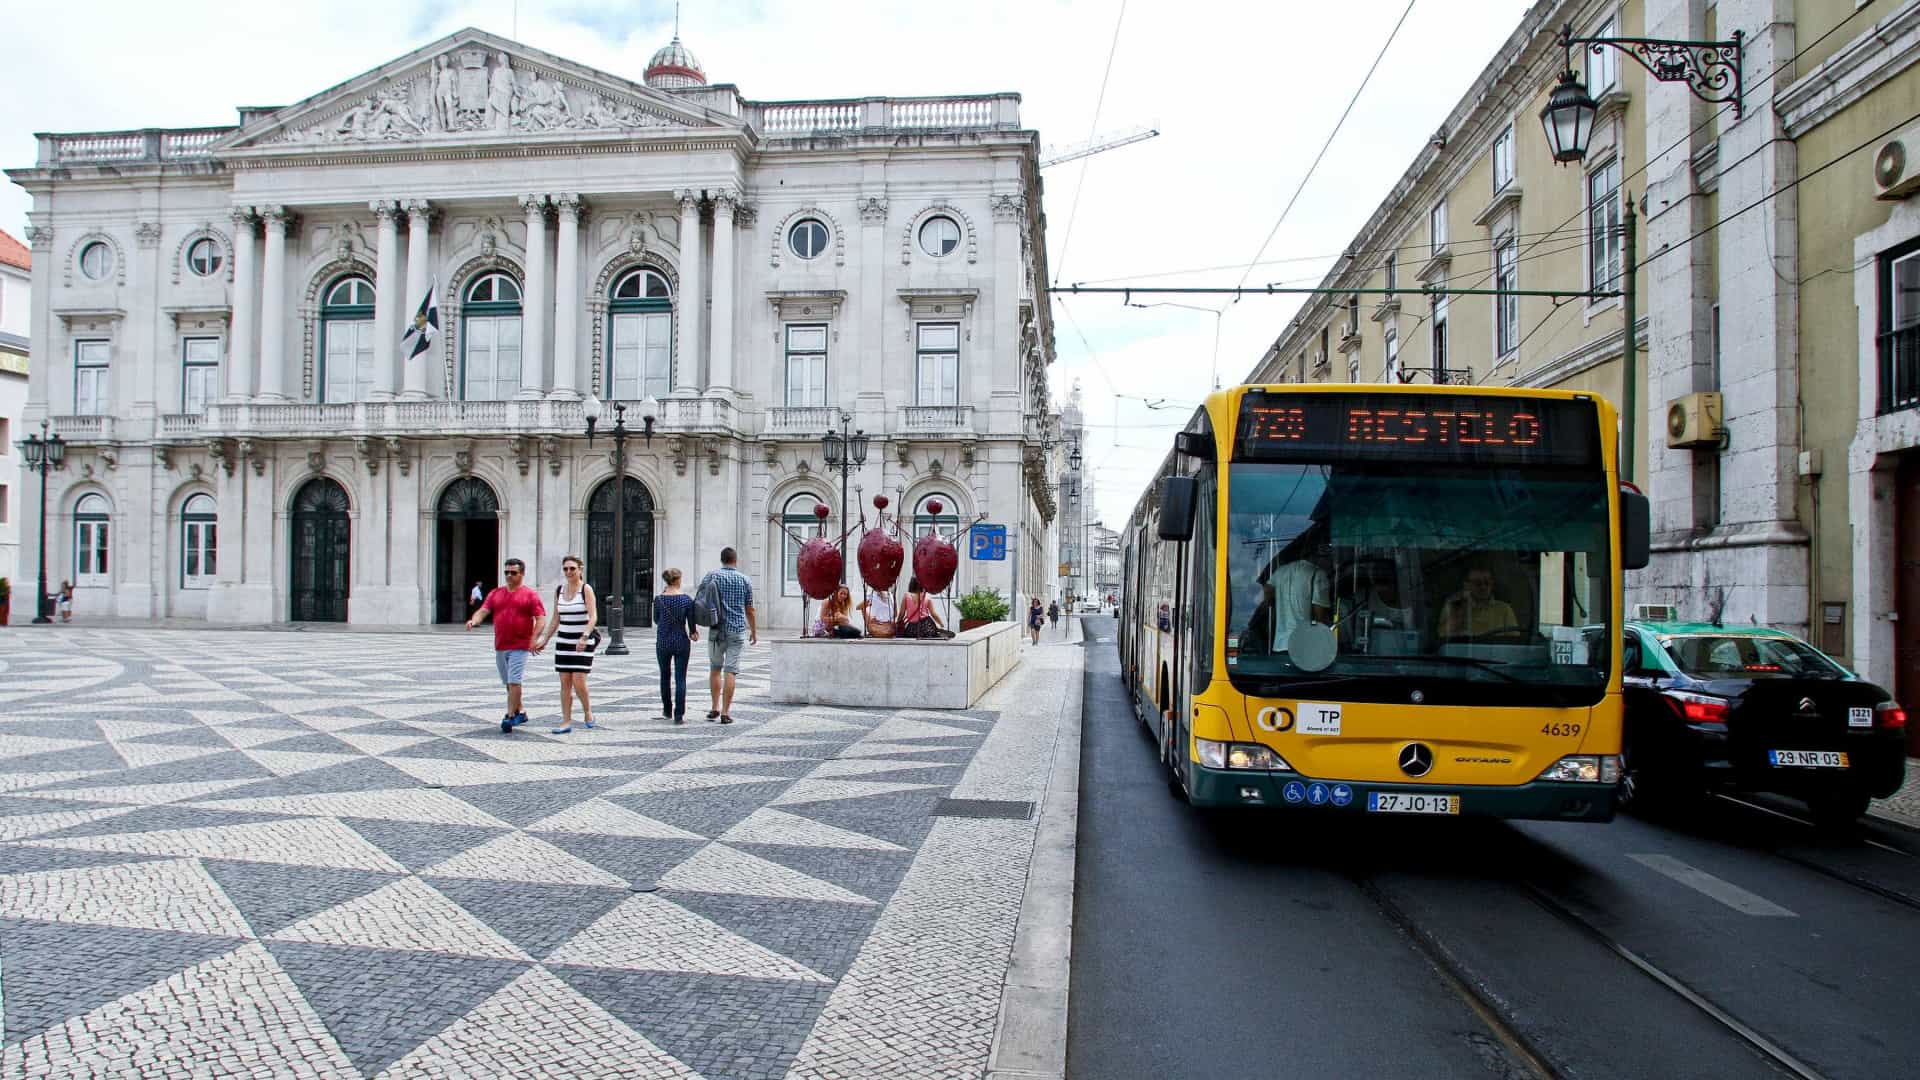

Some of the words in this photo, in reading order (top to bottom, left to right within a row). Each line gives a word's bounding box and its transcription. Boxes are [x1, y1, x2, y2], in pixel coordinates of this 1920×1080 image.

[1252, 407, 1304, 440] 728
[1349, 409, 1541, 445] RESTELO
[973, 534, 989, 558] P
[1318, 710, 1340, 724] TP
[1541, 723, 1580, 737] 4639
